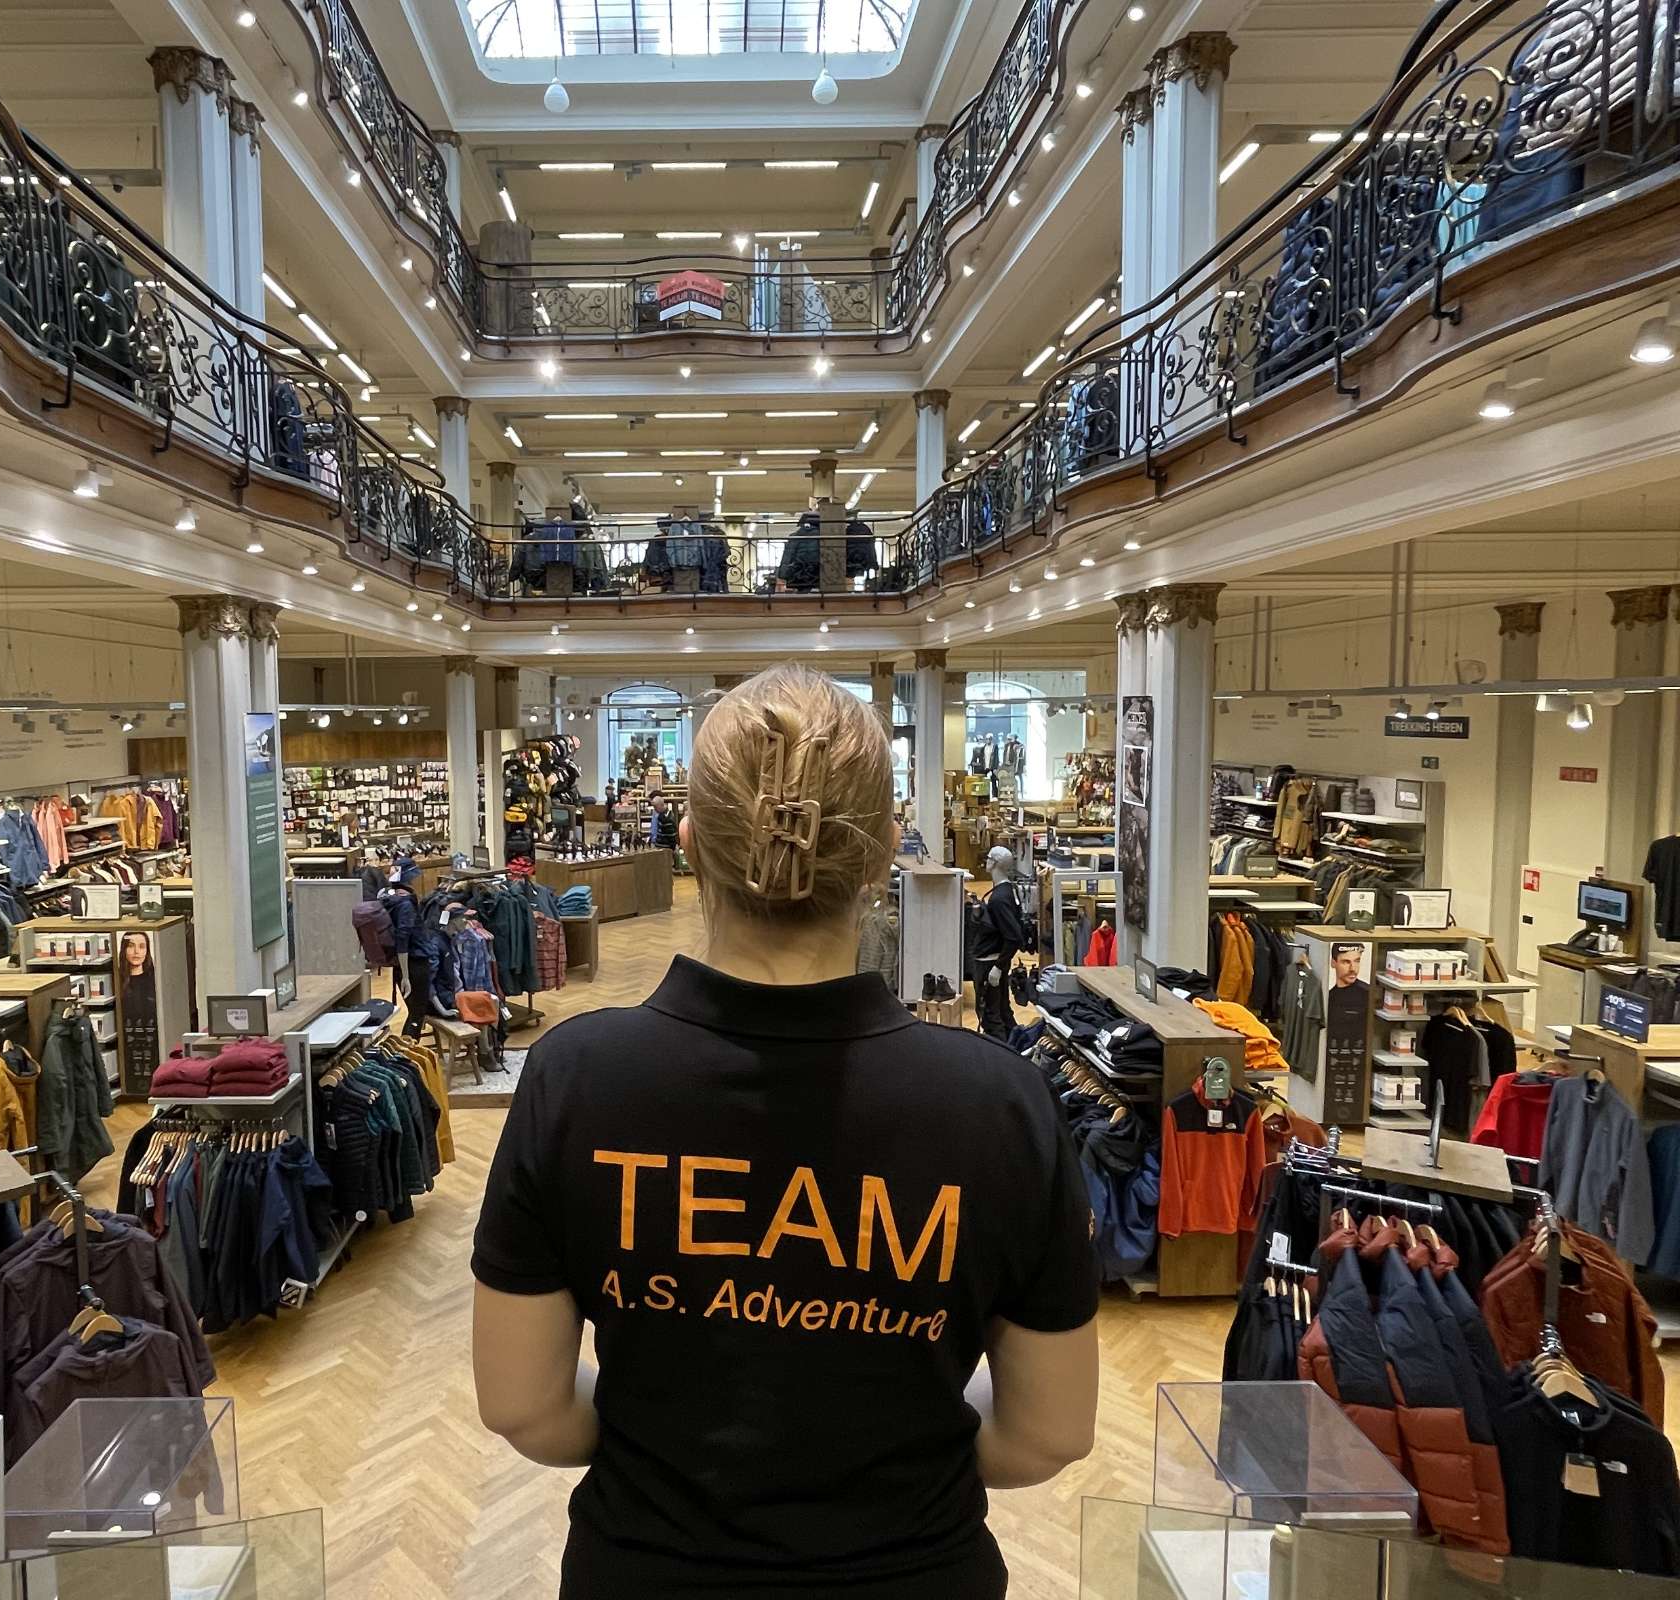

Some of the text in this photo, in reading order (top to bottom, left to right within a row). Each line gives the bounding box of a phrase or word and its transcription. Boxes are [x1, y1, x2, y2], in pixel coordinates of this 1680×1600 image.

[1390, 720, 1464, 734] TREKKING HEREN
[593, 1150, 961, 1282] TEAM
[601, 1269, 948, 1342] A.S. Adventure
